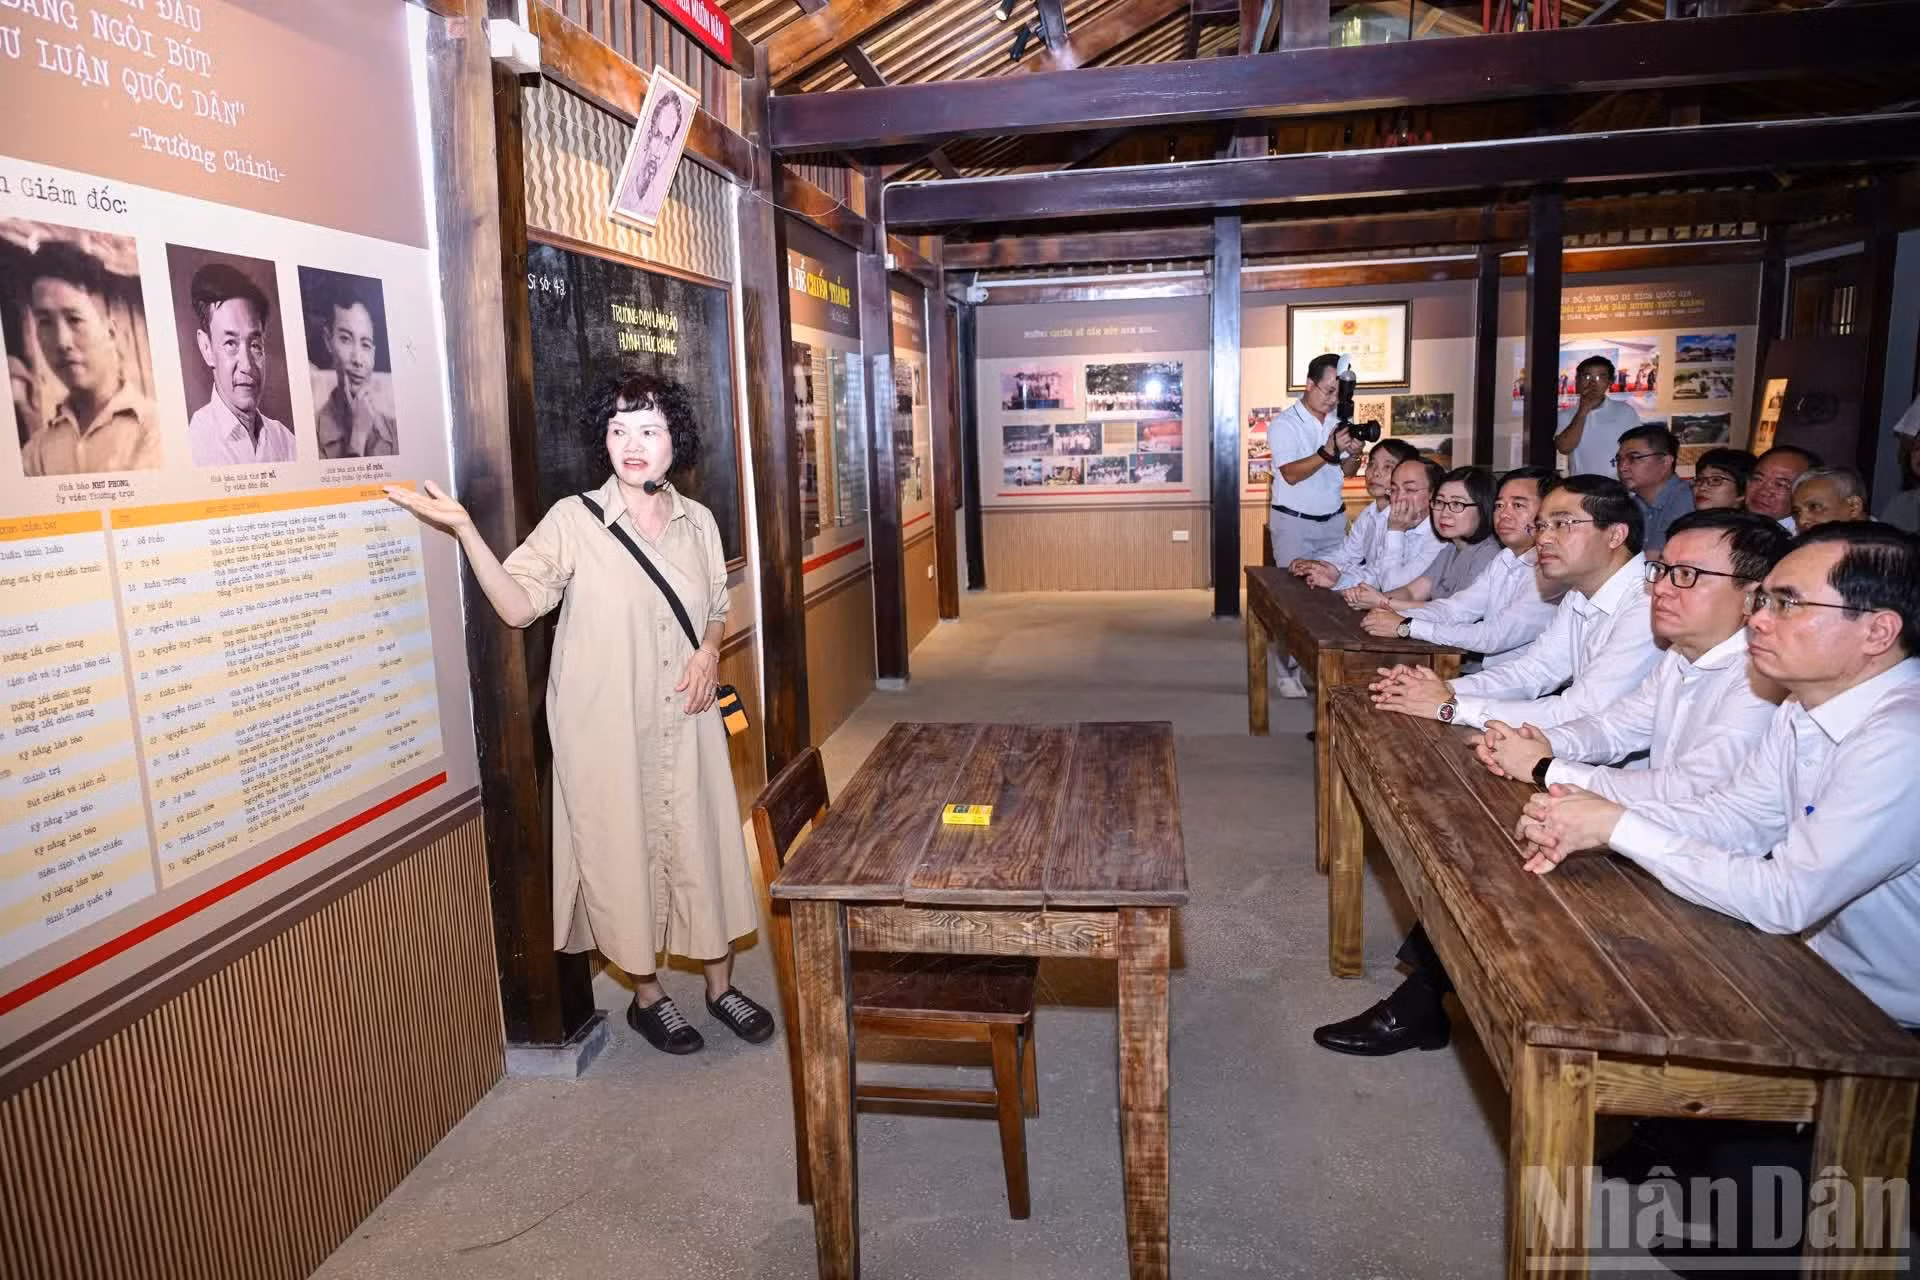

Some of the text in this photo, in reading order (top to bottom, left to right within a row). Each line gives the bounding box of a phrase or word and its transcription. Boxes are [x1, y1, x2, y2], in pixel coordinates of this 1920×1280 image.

[89, 10, 156, 58] NGÒI
[165, 37, 211, 78] BÚT
[35, 38, 110, 88] LUẬN
[122, 67, 183, 109] QUỐC
[20, 176, 77, 206] Giám
[87, 185, 128, 213] đốc:
[611, 301, 639, 325] TRƯỜNG
[640, 330, 657, 352] THÚC
[656, 333, 677, 356] KHÁNG
